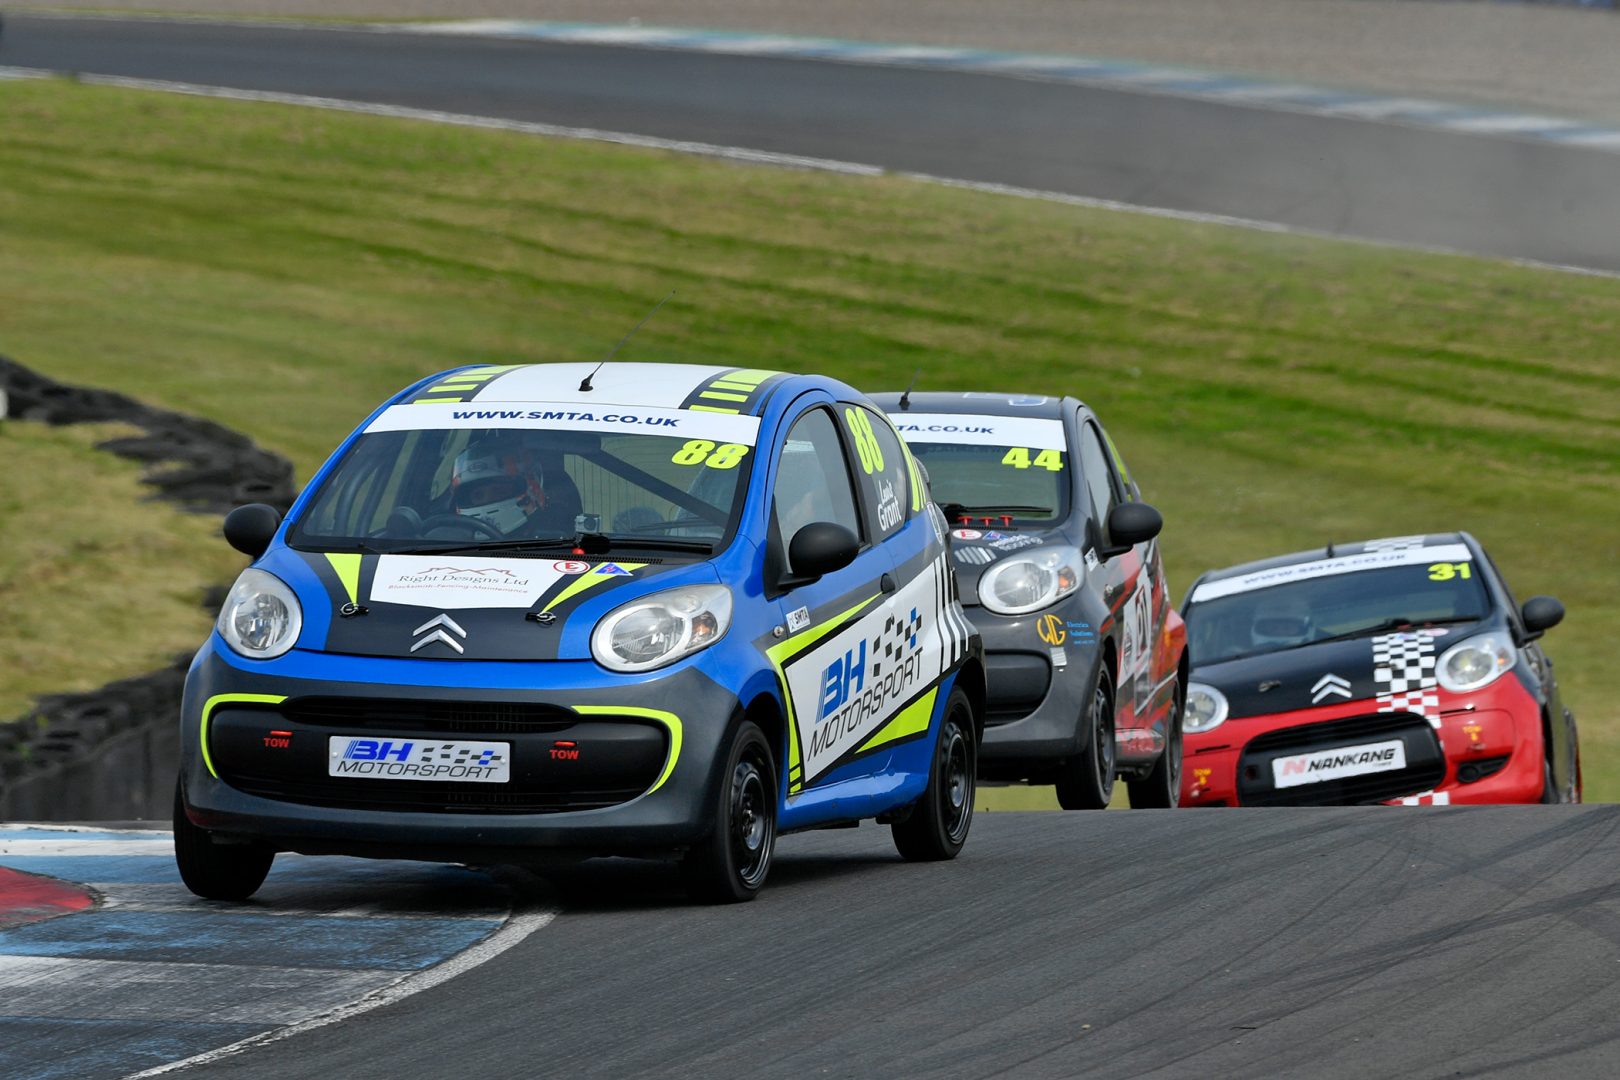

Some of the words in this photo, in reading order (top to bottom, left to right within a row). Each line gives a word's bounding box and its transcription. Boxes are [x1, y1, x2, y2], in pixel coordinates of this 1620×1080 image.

[452, 411, 681, 428] WWW.SMTA.CO.UK
[896, 425, 995, 434] TA.CO.UK
[845, 406, 884, 474] 88
[671, 439, 749, 470] 88
[1002, 447, 1063, 471] 44
[398, 575, 439, 584] Right
[442, 575, 500, 585] Designs
[504, 578, 529, 586] Ltd
[1427, 562, 1472, 582] 31
[815, 638, 867, 723] BH
[807, 646, 924, 762] MOTORSPORT
[263, 738, 290, 748] TOW
[344, 740, 414, 762] BH
[549, 749, 579, 760] TOW
[1308, 748, 1396, 772] NANKANG
[337, 761, 498, 780] MOTORSPORT
